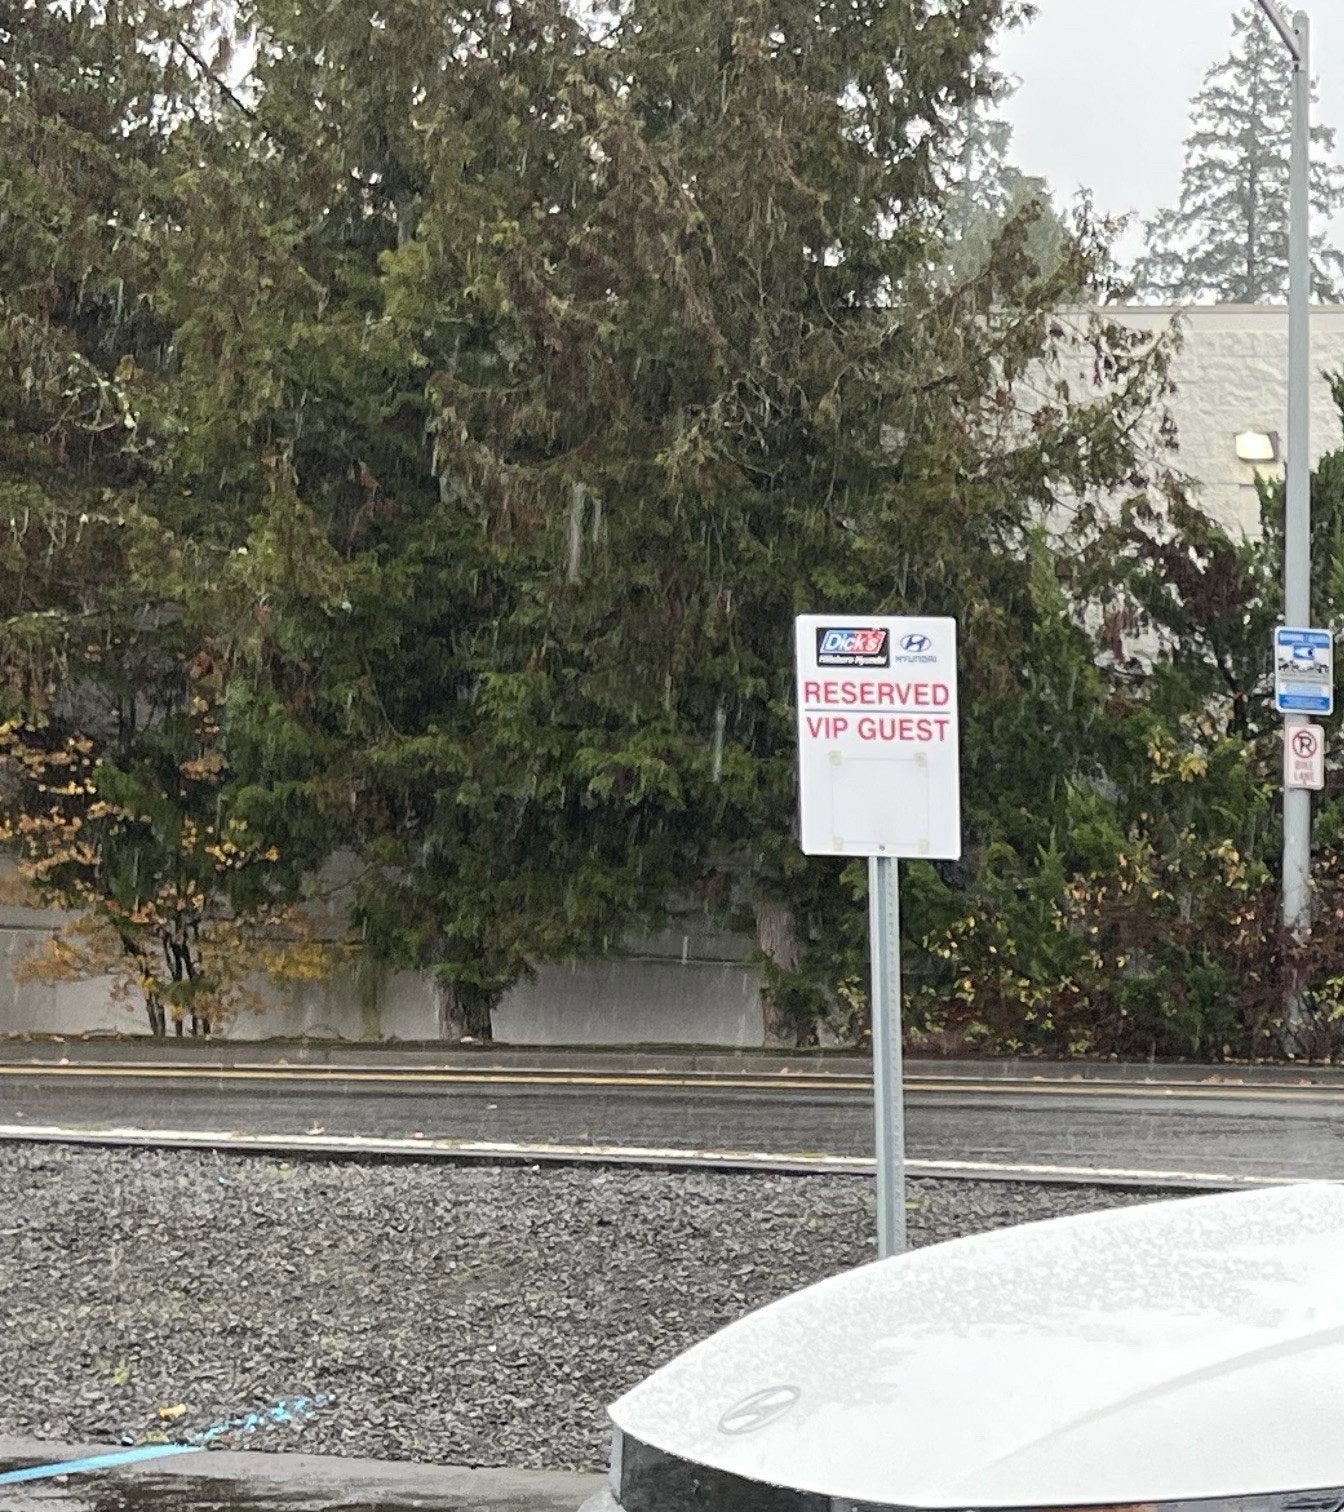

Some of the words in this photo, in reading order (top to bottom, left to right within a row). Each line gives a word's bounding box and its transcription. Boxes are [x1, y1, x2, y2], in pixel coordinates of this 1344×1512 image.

[804, 681, 950, 706] RESERVED
[806, 716, 849, 739] VIP
[858, 718, 950, 742] GUEST
